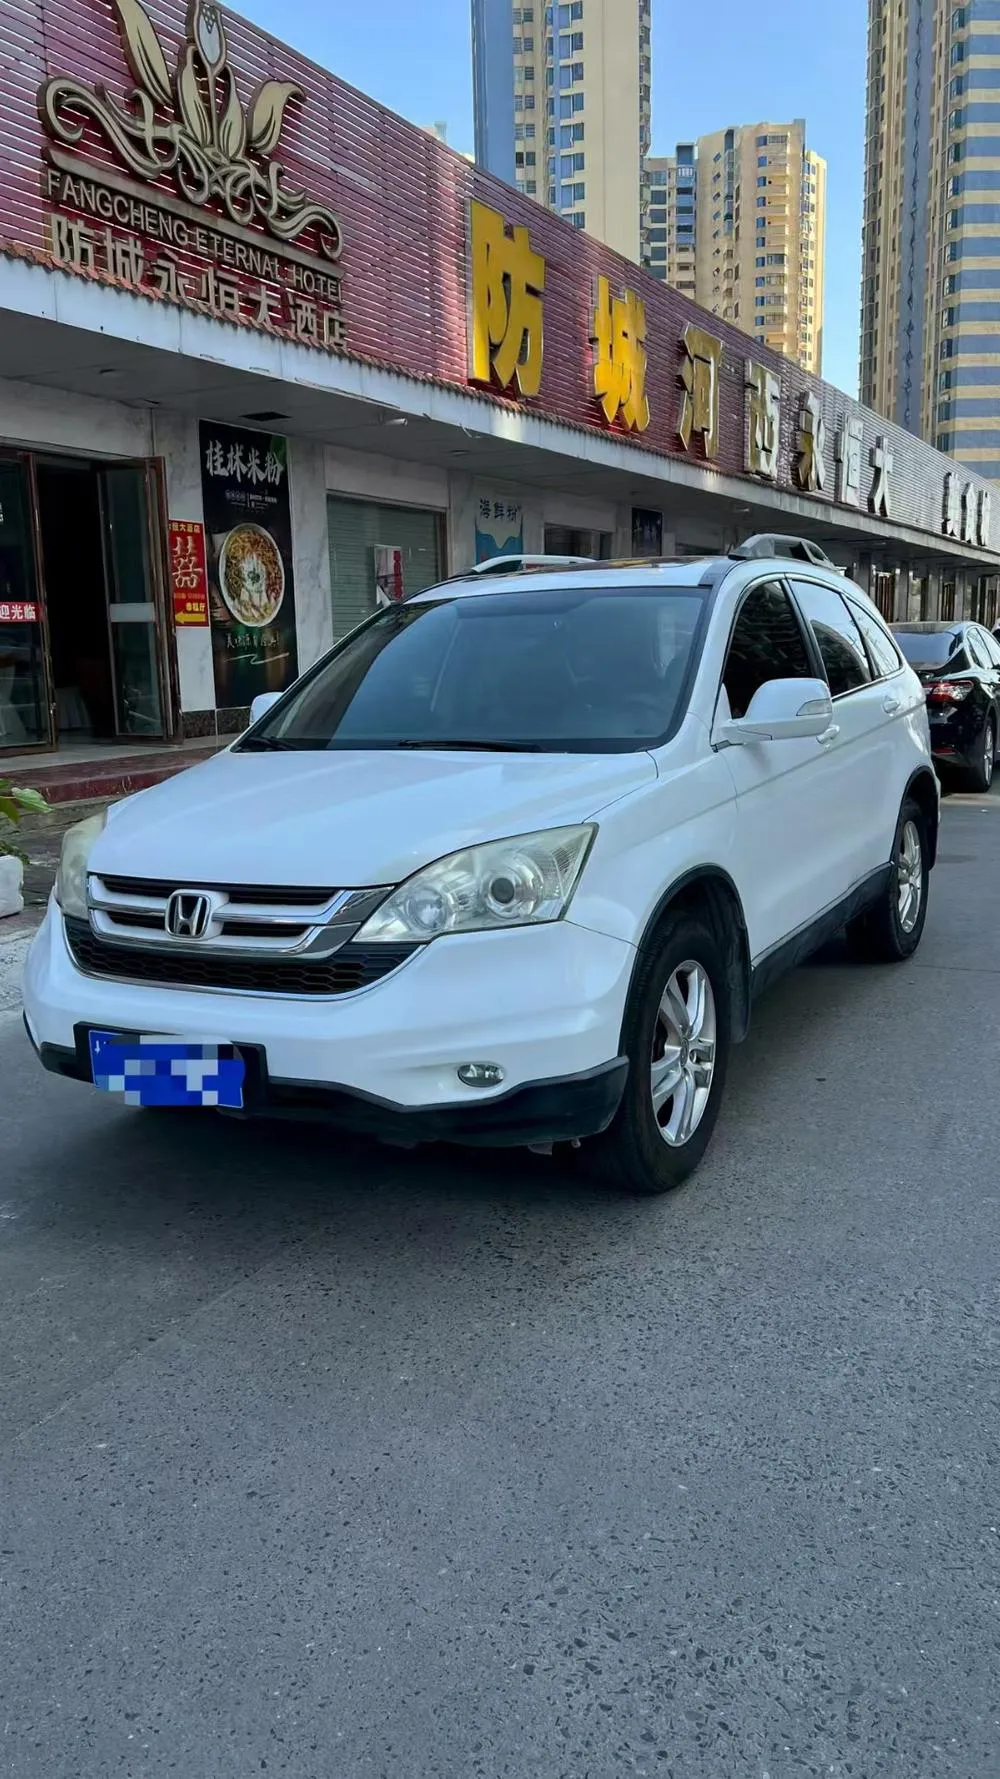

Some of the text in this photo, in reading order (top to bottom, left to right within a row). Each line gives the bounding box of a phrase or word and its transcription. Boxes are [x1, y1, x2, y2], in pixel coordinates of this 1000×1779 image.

[48, 169, 344, 304] FANGCHENG ETERNAL HOTEL
[50, 213, 347, 349] 防城永恒大酒店
[205, 439, 284, 486] 桂林米粉
